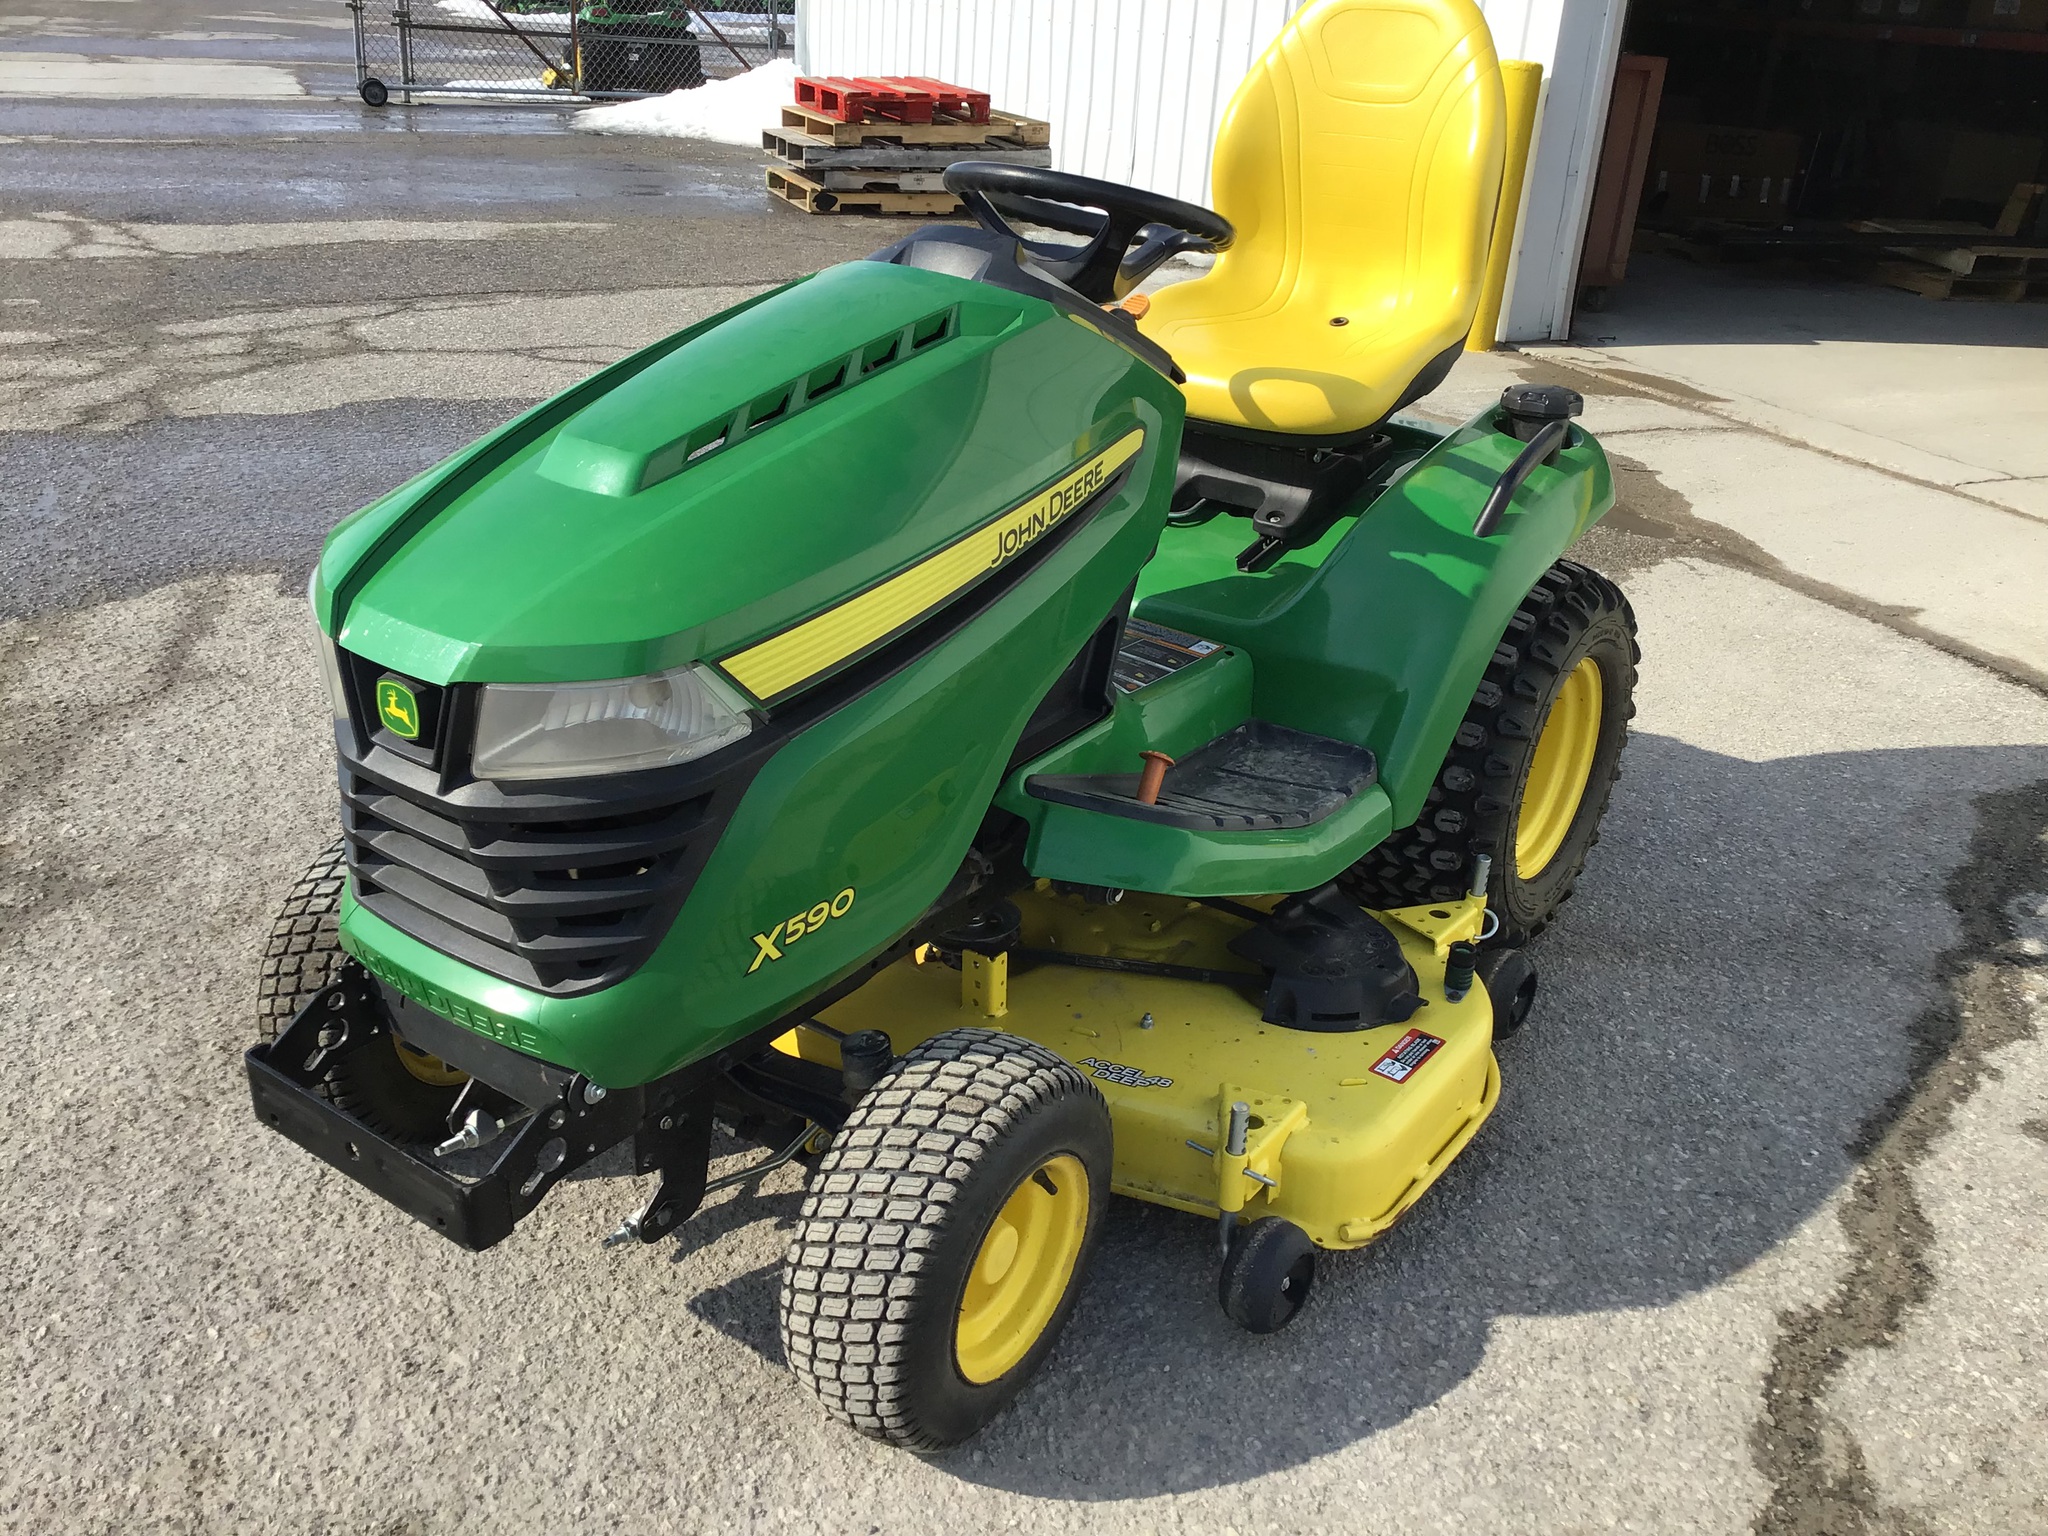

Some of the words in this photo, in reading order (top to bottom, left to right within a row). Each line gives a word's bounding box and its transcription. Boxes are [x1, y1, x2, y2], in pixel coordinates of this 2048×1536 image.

[991, 507, 1045, 566] JOHN
[1050, 460, 1104, 523] DEERE
[743, 886, 856, 978] X590
[422, 981, 542, 1055] DEERE
[1076, 1057, 1145, 1079] ACCEL
[1091, 1068, 1150, 1087] DEEP
[1145, 1076, 1174, 1088] 48
